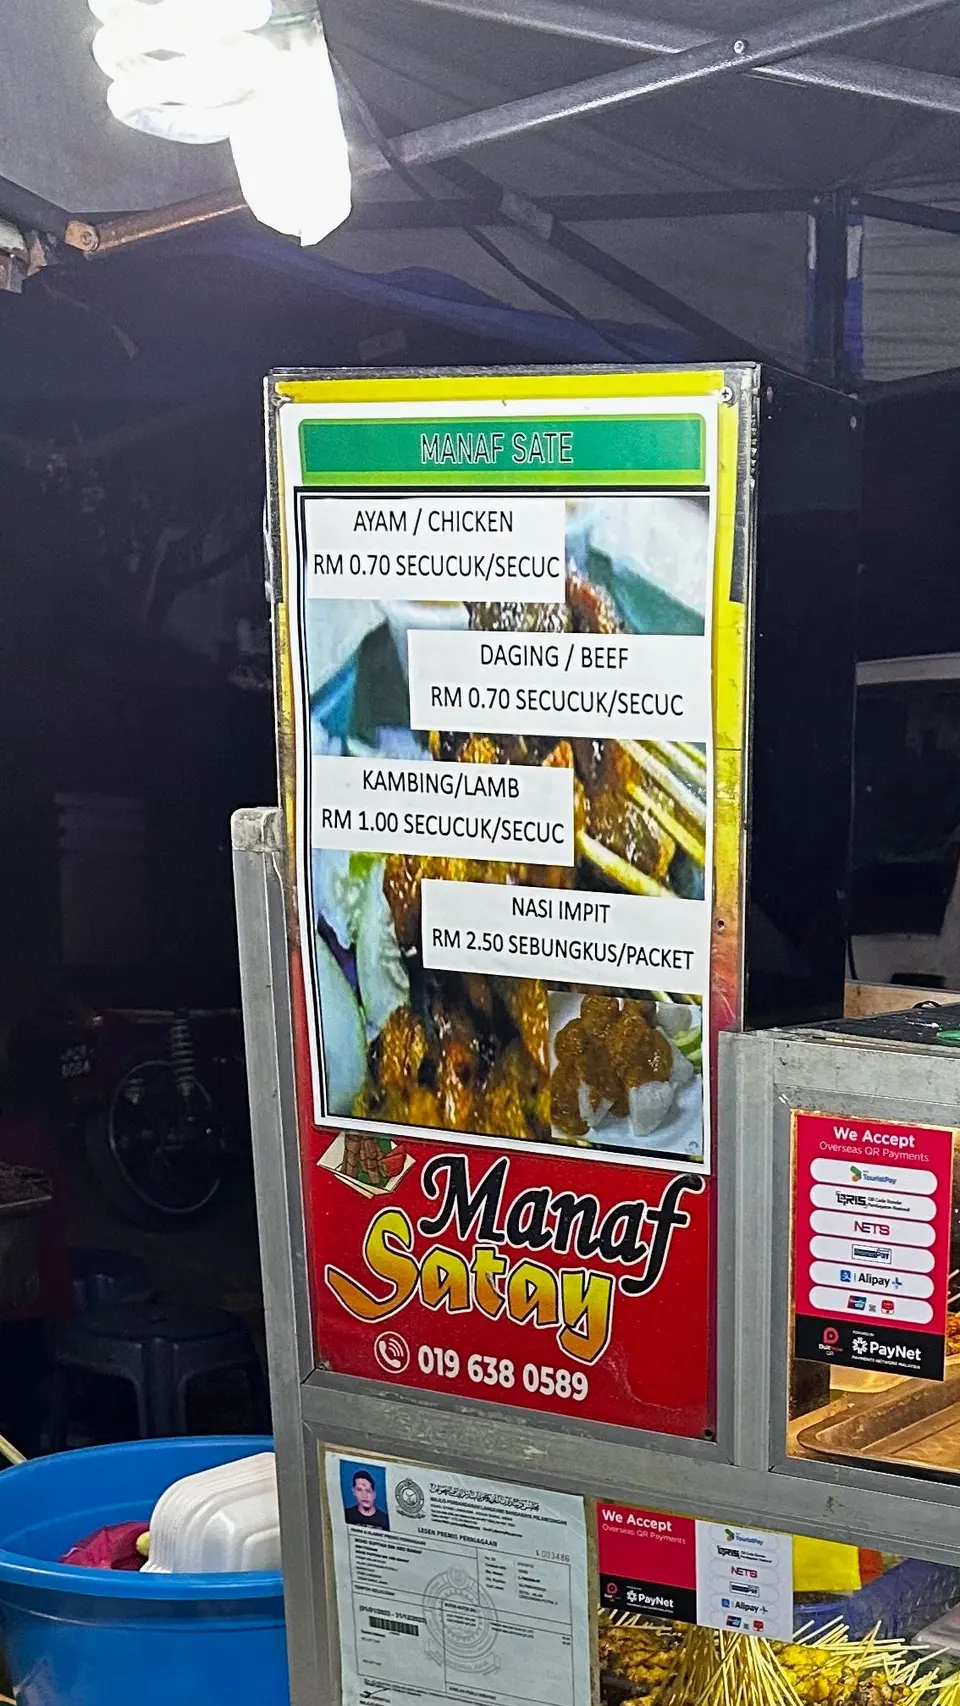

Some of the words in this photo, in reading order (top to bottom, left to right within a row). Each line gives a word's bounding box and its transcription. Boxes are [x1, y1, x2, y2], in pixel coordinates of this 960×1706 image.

[420, 432, 504, 465] MANAF
[512, 432, 574, 464] SATE
[353, 509, 408, 533] AYAM
[427, 510, 514, 533] CHICKEN
[313, 554, 345, 577] RM
[349, 554, 391, 577] 0.70
[396, 554, 560, 582] SECUCUK/SECUC
[480, 643, 559, 669] DAGING
[580, 646, 629, 670] BEEF
[431, 687, 464, 708] RM
[468, 688, 510, 711] 0.70
[515, 689, 684, 717] SECUCUK/SECUC
[362, 769, 520, 799] KAMBING/LAMB
[321, 808, 352, 830] RM
[357, 811, 399, 833] 1.00
[403, 815, 565, 844] SECUCUK/SECUC
[511, 897, 553, 921] NASI
[558, 900, 610, 924] IMPIT
[432, 928, 461, 951] RM
[465, 930, 504, 954] 2.50
[508, 934, 695, 971] SEBUNGKUS/PACKET
[833, 1126, 858, 1141] We
[862, 1130, 915, 1148] Accept
[820, 1141, 862, 1155] Overseas
[865, 1147, 880, 1156] QR
[883, 1149, 929, 1162] Payments
[419, 1153, 706, 1297] Manaf
[854, 1221, 890, 1235] NETS
[325, 1207, 615, 1366] Satay
[870, 1341, 921, 1361] PayNet
[418, 1345, 460, 1378] 019
[466, 1353, 516, 1389] 638
[522, 1362, 589, 1402] 0589
[602, 1509, 623, 1523] We
[626, 1513, 672, 1532] Accept
[602, 1523, 635, 1536] Overseas
[636, 1529, 649, 1538] QR
[649, 1531, 686, 1545] Payments
[638, 1593, 674, 1608] PayNet
